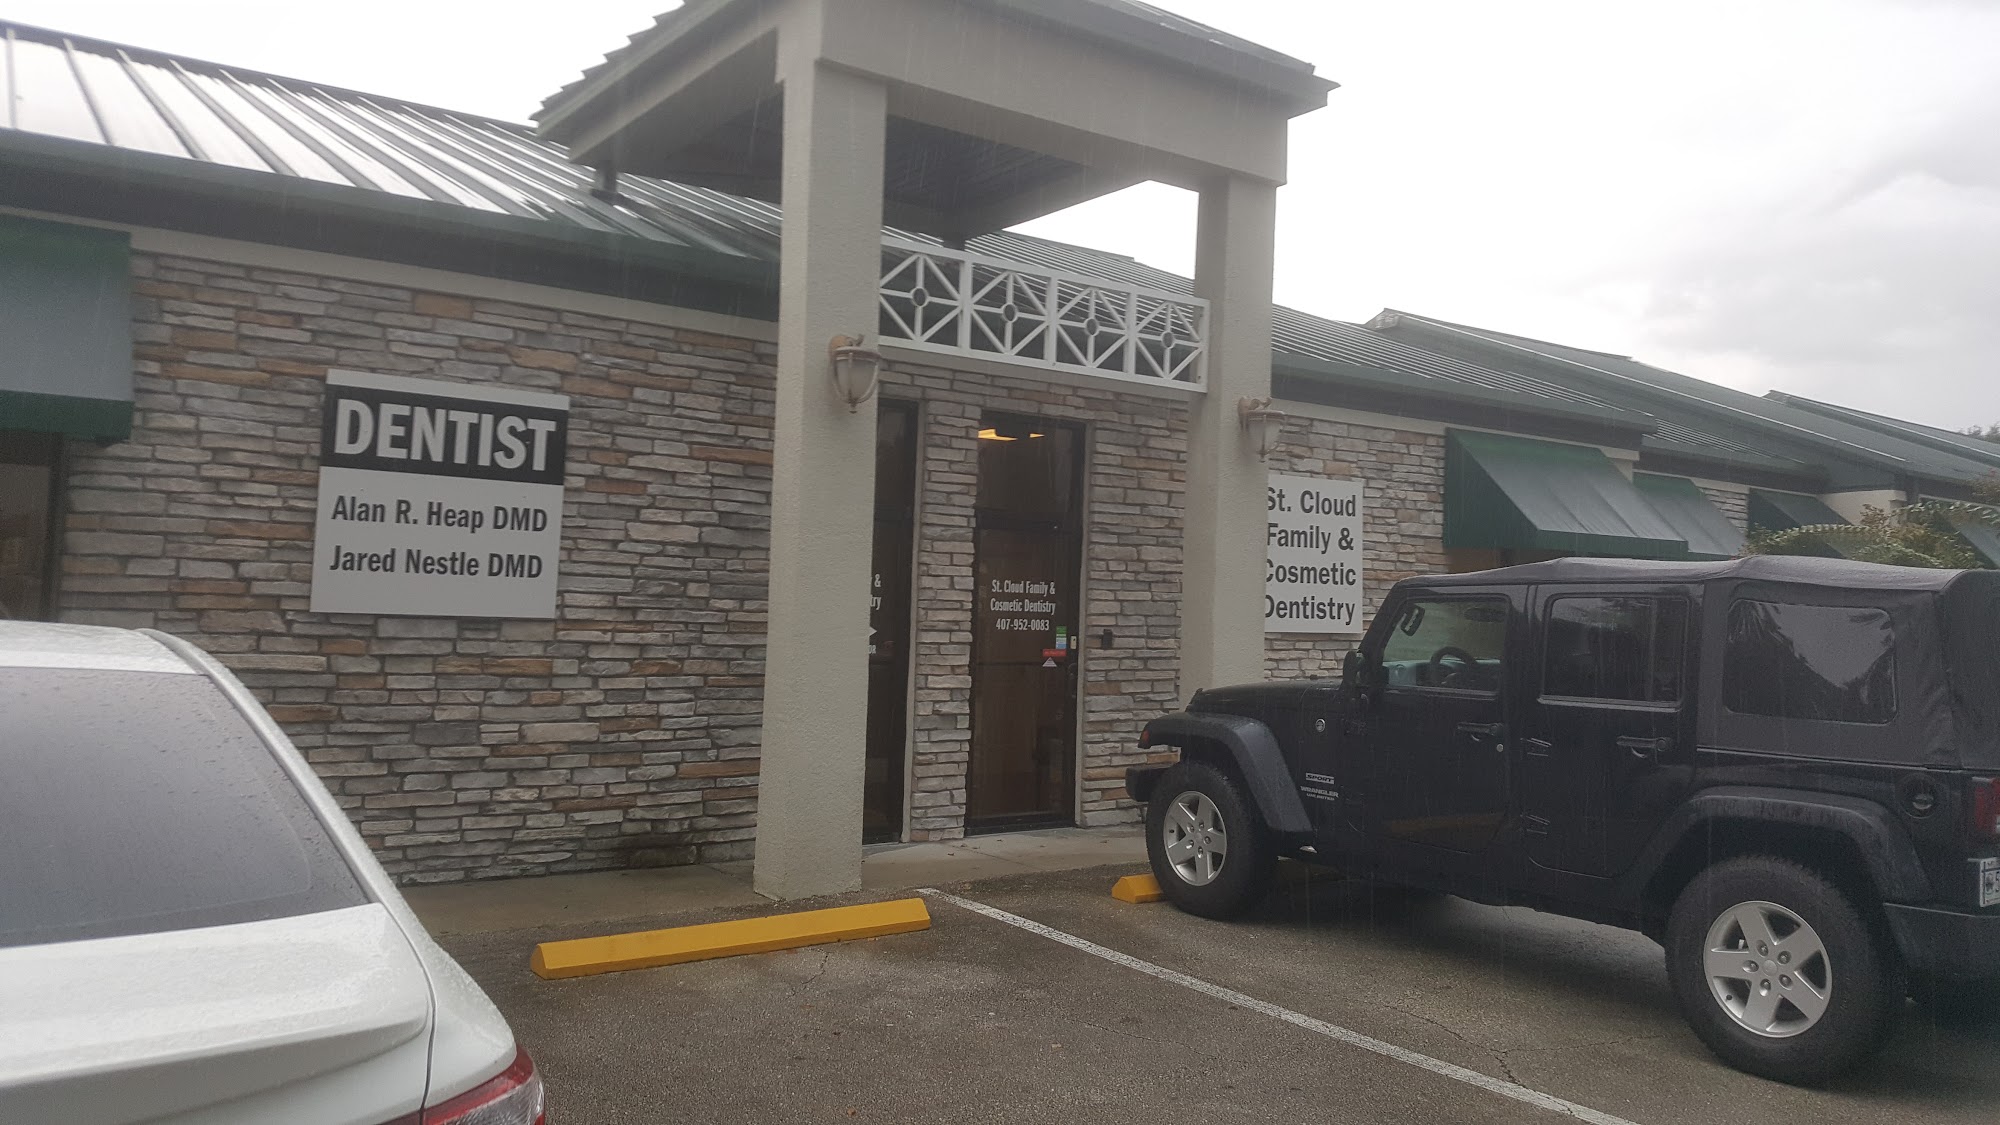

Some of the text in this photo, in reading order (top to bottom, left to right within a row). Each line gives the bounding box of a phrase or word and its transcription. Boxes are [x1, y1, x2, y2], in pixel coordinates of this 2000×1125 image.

[334, 398, 557, 471] DENTIST
[331, 495, 548, 533] Alan R. Heap DMD
[1268, 486, 1356, 517] St. Cloud
[1267, 522, 1354, 554] Family &
[329, 545, 543, 578] Jared Nestle DMD
[991, 579, 1056, 597] St. Cloud Family &
[990, 597, 1056, 615] Cosmetic Dentistry
[1265, 594, 1355, 625] Dentistry
[995, 618, 1050, 631] 407-952-0083
[1300, 786, 1339, 798] WRANGLER
[1307, 773, 1333, 783] SPORT
